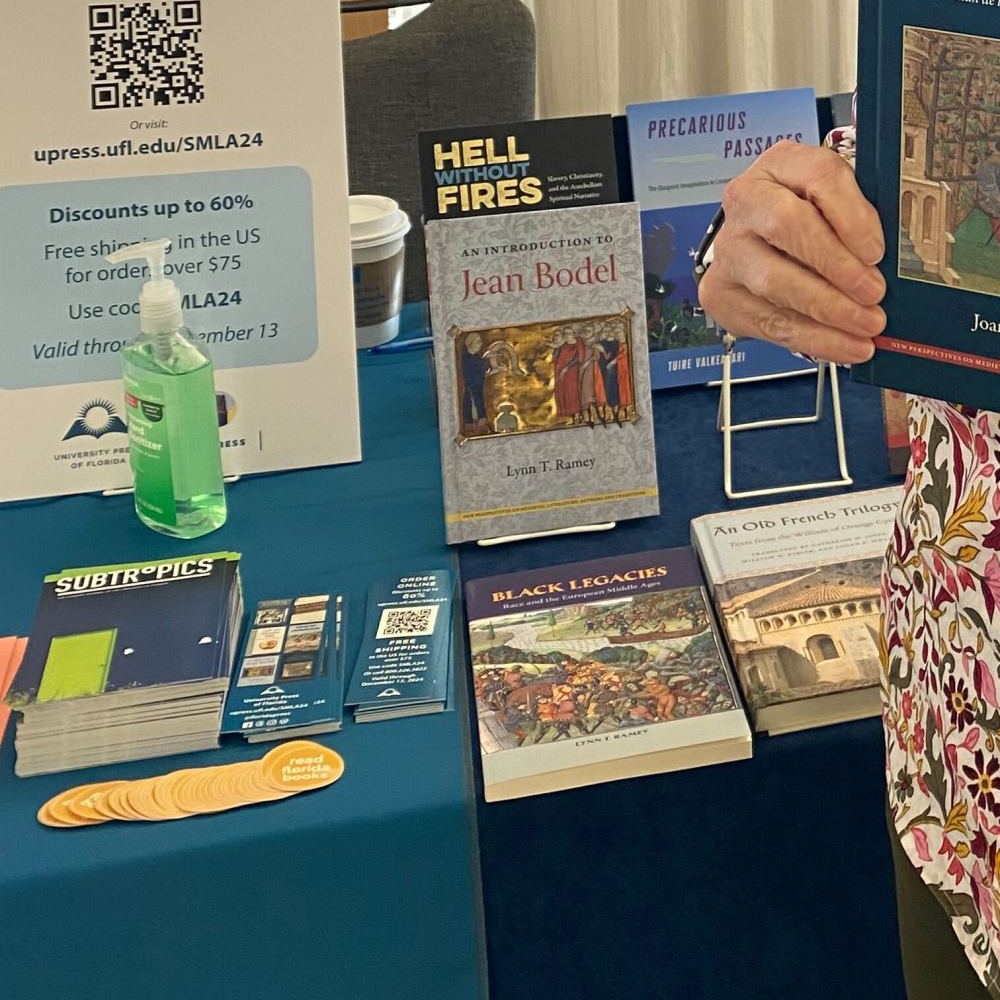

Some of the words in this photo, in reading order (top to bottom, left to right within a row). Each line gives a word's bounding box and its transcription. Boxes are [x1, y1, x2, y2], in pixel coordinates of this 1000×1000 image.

[130, 120, 144, 130] Or
[145, 118, 168, 129] visit:
[648, 111, 746, 139] PRECARIOUS
[34, 132, 264, 165] upress.ufl.edu/SMLA24
[434, 135, 530, 170] HELL
[434, 162, 530, 186] WITHOUT
[437, 176, 543, 214] FIRES
[50, 203, 149, 224] Discounts
[154, 201, 179, 219] up
[184, 199, 205, 213] to
[210, 194, 254, 212] 60%
[44, 243, 85, 261] Free
[178, 234, 195, 249] in
[200, 230, 230, 247] the
[236, 228, 261, 245] US
[461, 248, 479, 258] AN
[485, 236, 592, 256] INTRODUCTION
[598, 234, 613, 244] TO
[66, 265, 90, 283] for
[98, 263, 152, 281] order
[164, 260, 202, 276] over
[209, 255, 241, 273] $75
[461, 268, 524, 301] Jean
[535, 254, 618, 290] Bodel
[69, 301, 103, 320] Use
[109, 302, 141, 316] co
[182, 291, 242, 310] MLA24
[33, 340, 77, 360] Valid
[84, 337, 126, 356] thro
[259, 322, 279, 339] 13
[668, 358, 692, 372] TUIRE
[695, 351, 746, 368] VALKEAARI
[909, 345, 962, 361] PERSPECTIVES
[963, 355, 974, 364] ON
[54, 448, 110, 460] UNIVERSITY
[113, 446, 130, 454] PRE
[218, 439, 246, 449] RESS
[86, 458, 126, 467] FLORIDA
[507, 464, 537, 480] Lynn
[555, 457, 596, 473] Ramey
[714, 526, 737, 537] An
[743, 519, 776, 531] Old
[781, 511, 836, 526] French
[839, 500, 901, 517] Trilogy
[491, 583, 564, 602] BLACK
[569, 566, 668, 590] LEGACIES
[526, 598, 544, 606] and
[562, 590, 605, 601] European
[607, 584, 638, 594] Middle
[640, 581, 661, 589] Ages
[375, 644, 427, 653] SHIPPING
[575, 738, 602, 746] LYNN
[282, 764, 332, 775] florida
[289, 754, 324, 765] read
[282, 772, 329, 781] books
